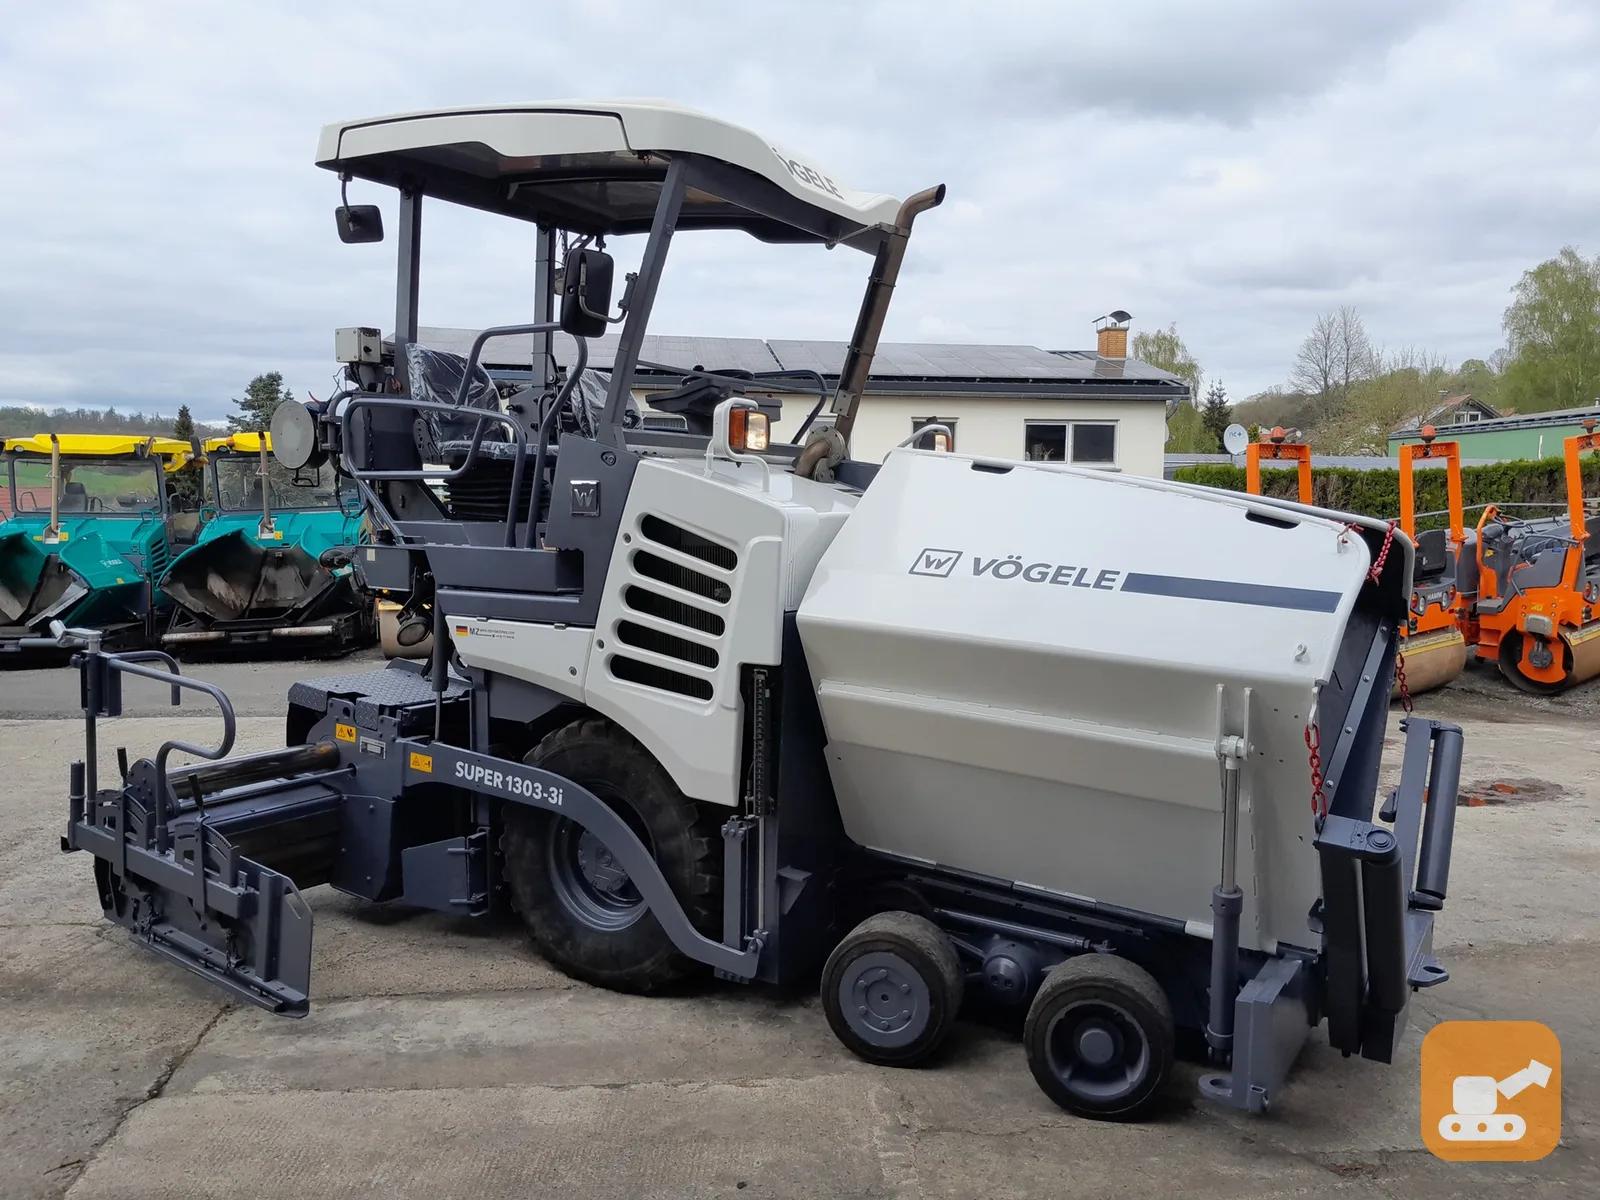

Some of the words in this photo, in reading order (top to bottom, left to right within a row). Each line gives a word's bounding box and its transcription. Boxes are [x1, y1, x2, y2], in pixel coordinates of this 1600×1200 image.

[972, 554, 1121, 591] VÖGELE
[455, 761, 503, 789] SUPER
[505, 775, 563, 806] 1303-3i
